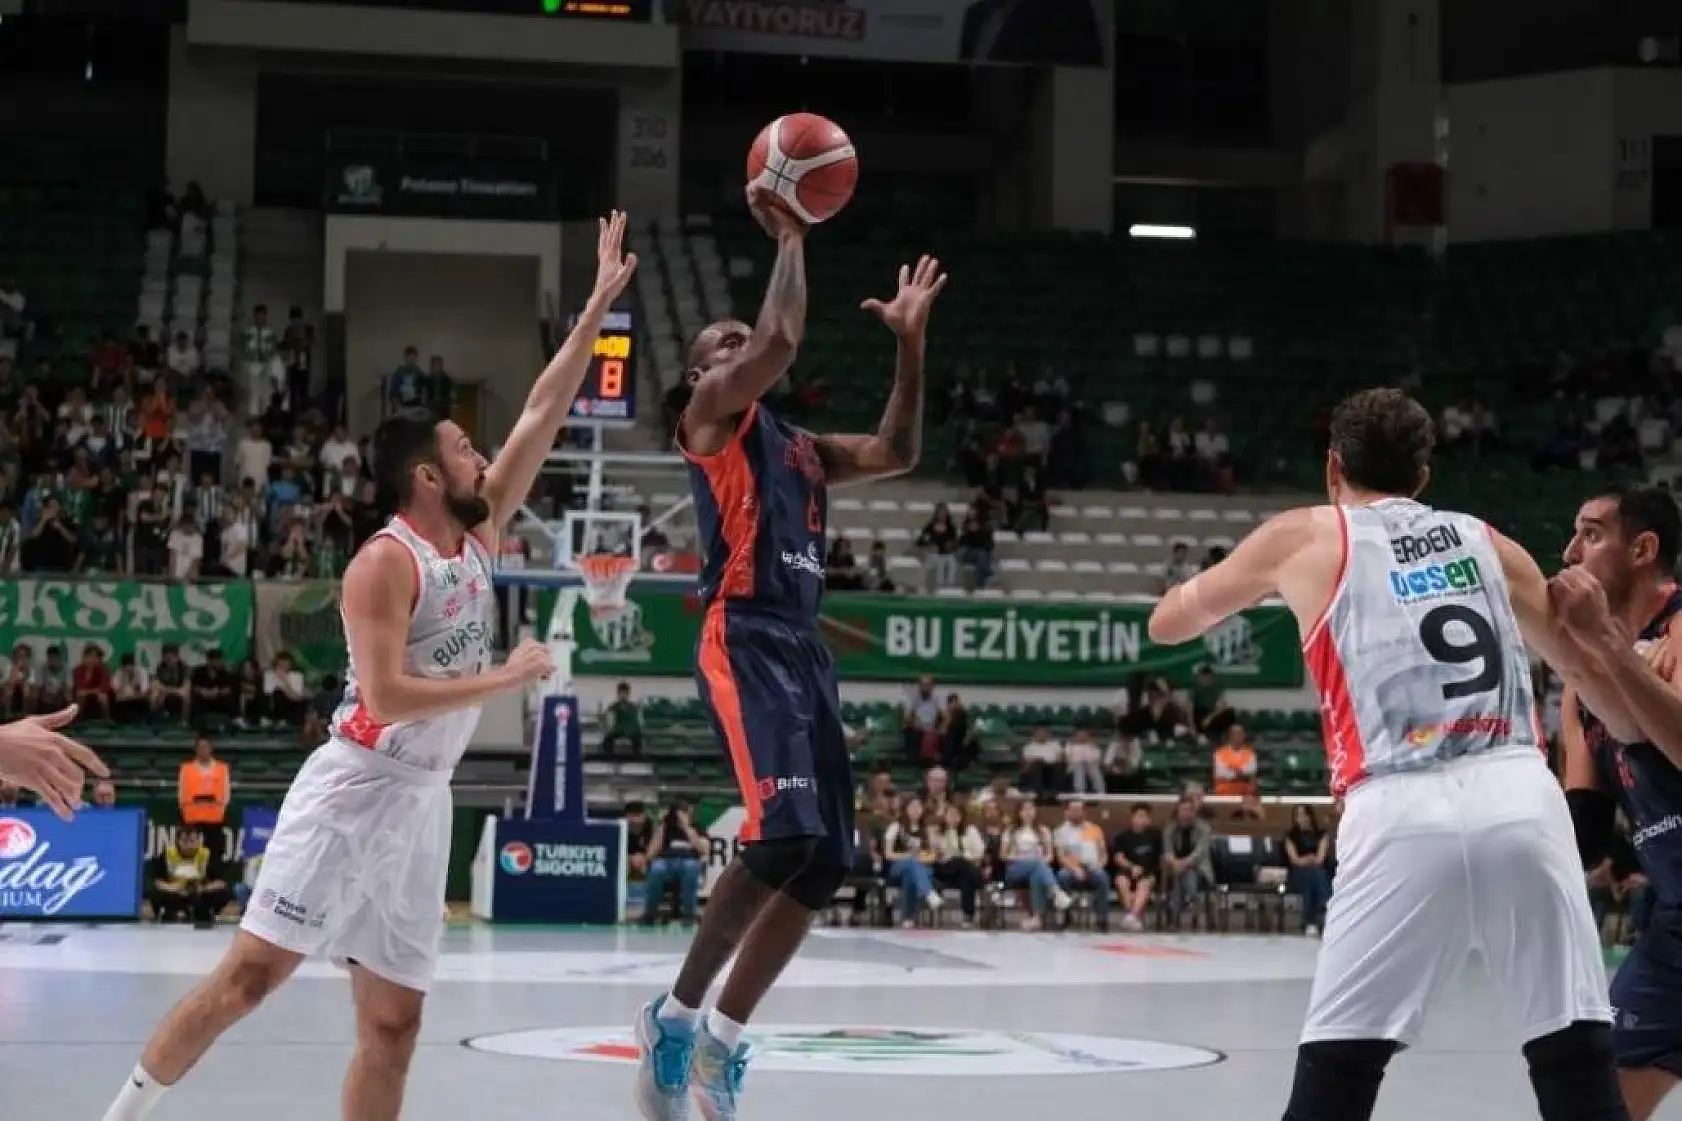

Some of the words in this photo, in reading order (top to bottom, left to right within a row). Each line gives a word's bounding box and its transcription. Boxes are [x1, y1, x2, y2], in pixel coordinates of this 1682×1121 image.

[600, 360, 623, 398] 8
[1391, 523, 1462, 564] ERDEN
[886, 616, 942, 657] BU
[953, 609, 1139, 662] EZİYETİN
[1419, 604, 1502, 700] 9
